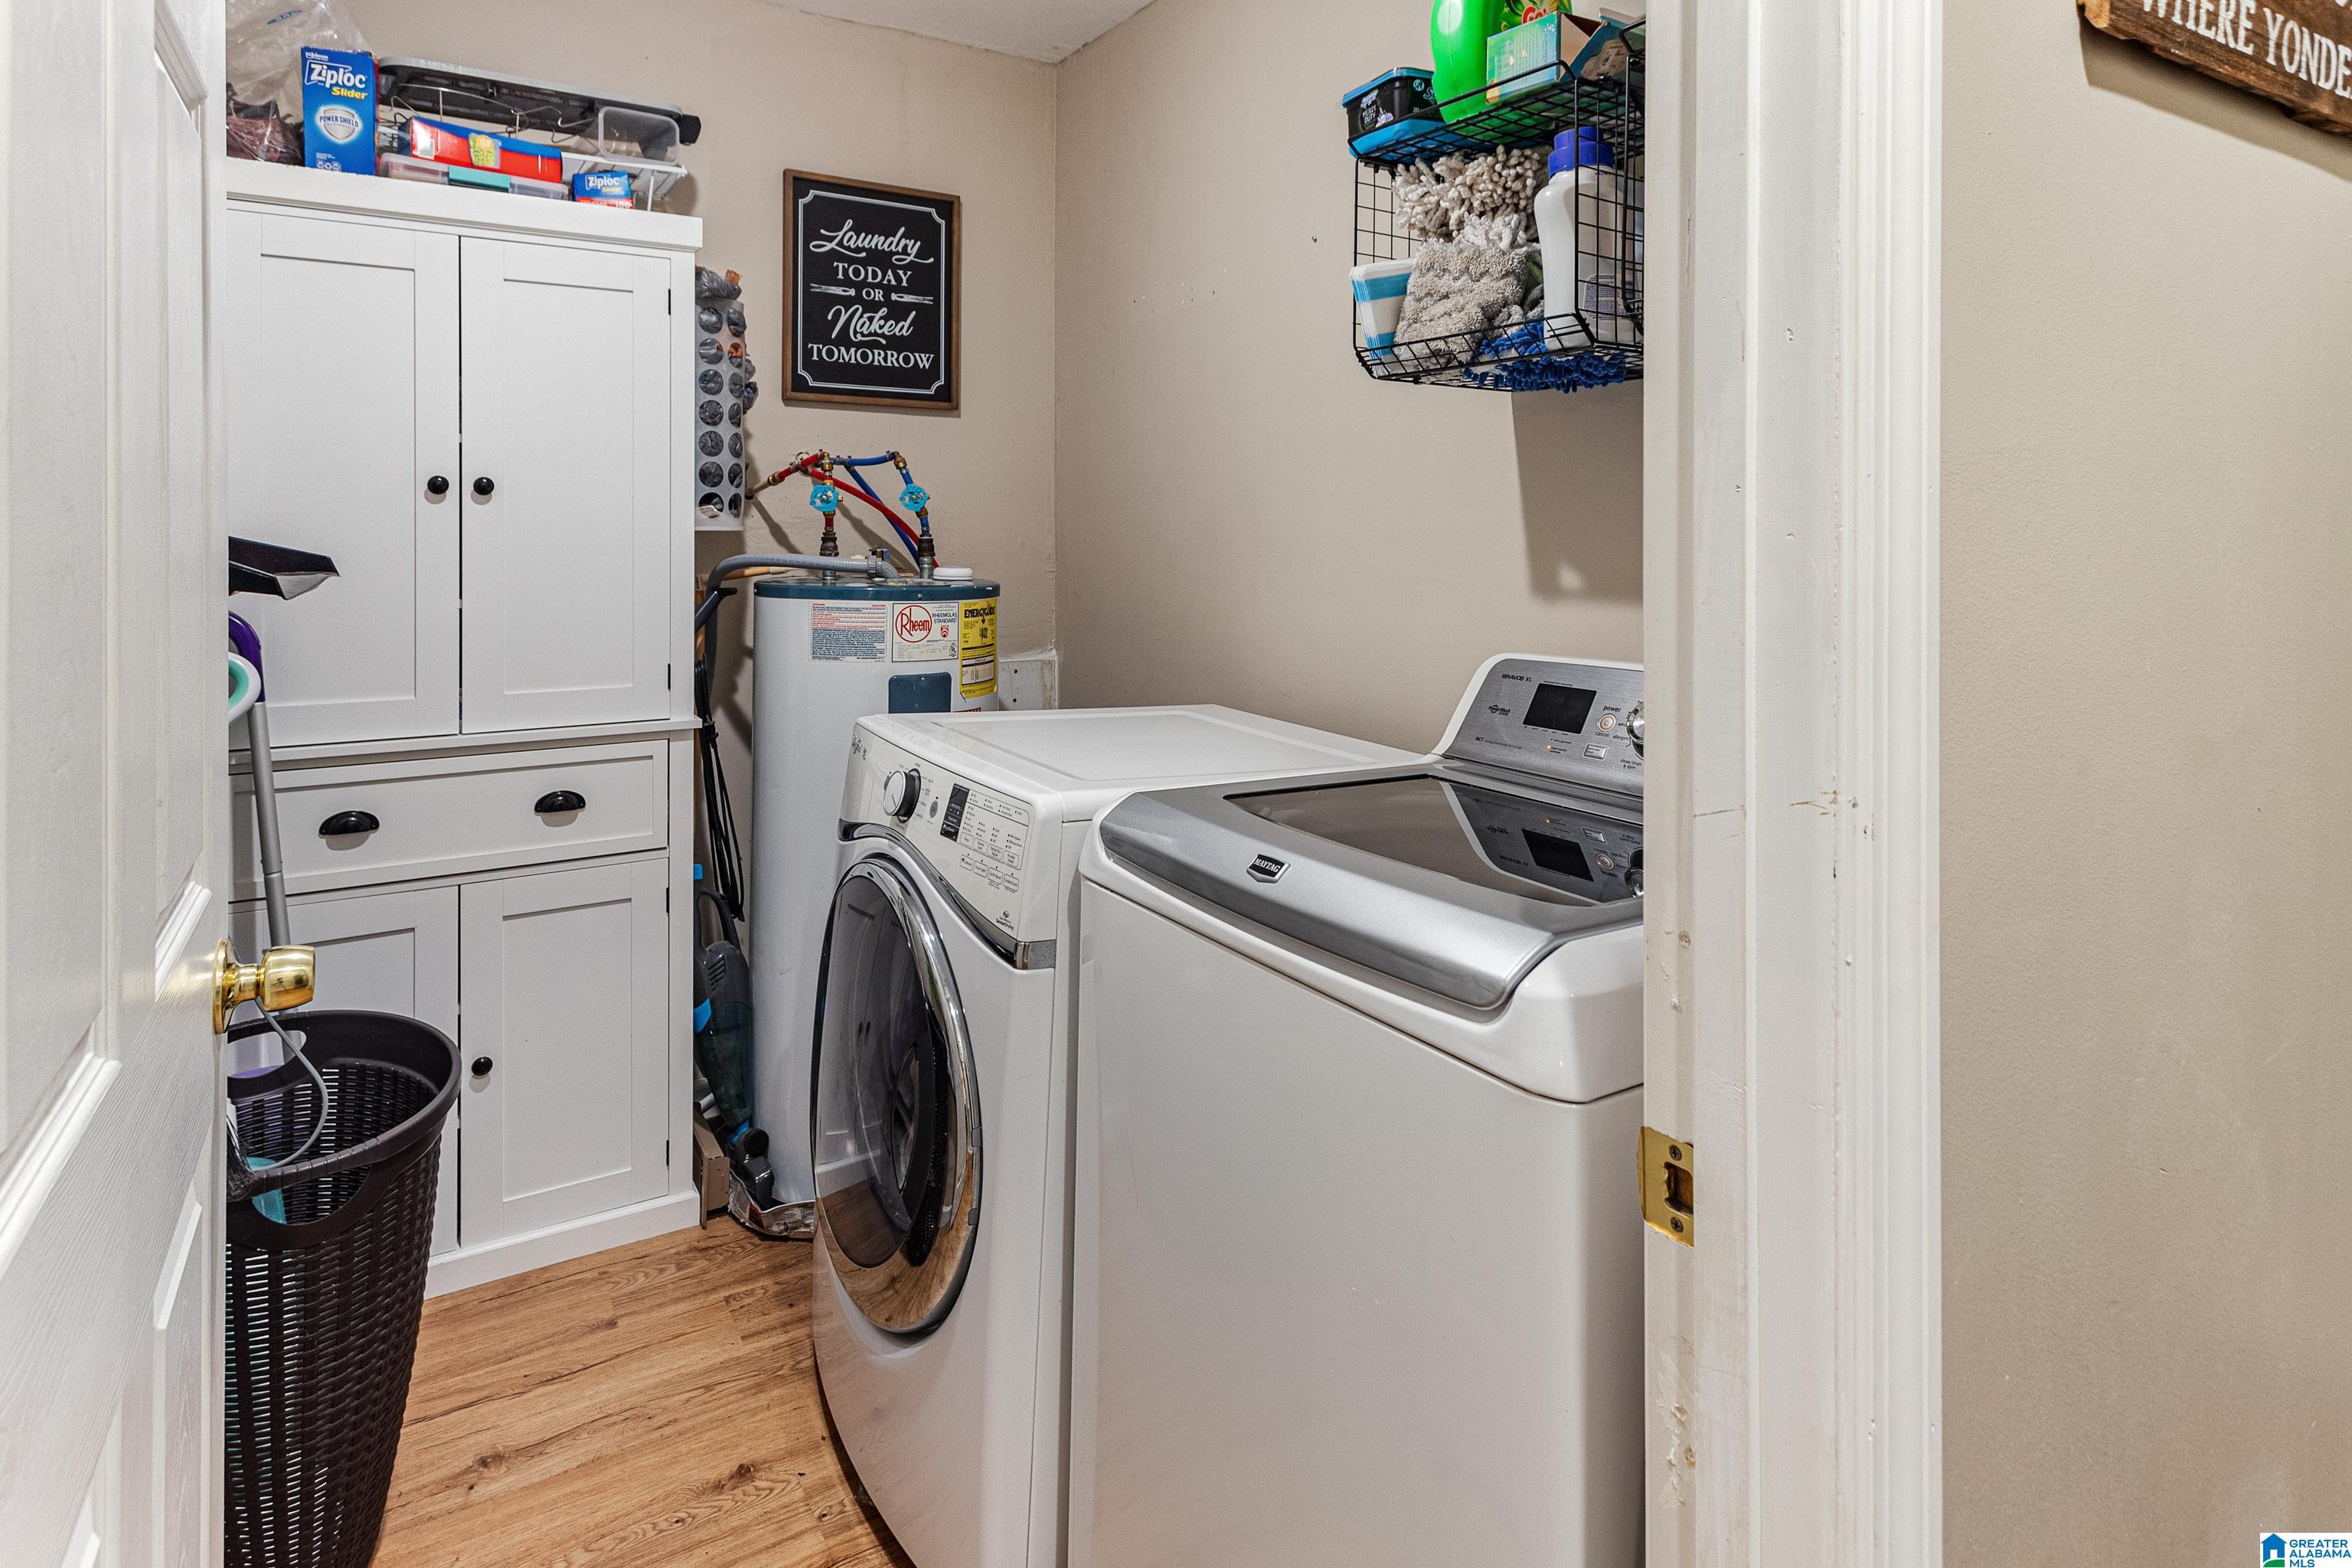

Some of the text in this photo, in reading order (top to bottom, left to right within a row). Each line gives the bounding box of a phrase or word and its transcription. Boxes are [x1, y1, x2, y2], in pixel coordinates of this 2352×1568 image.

[2262, 7, 2352, 100] YONDE
[310, 63, 366, 88] Ziploc
[332, 87, 368, 100] Slider
[340, 116, 358, 127] SHIELD
[587, 175, 620, 189] Ziploc
[809, 219, 934, 265] Laundry
[834, 262, 912, 286] TODAY
[862, 288, 884, 302] OR
[828, 304, 916, 345] Naked
[808, 342, 934, 370] TOMORROW
[900, 607, 931, 637] Rheem
[1253, 858, 1281, 873] MAYTAG
